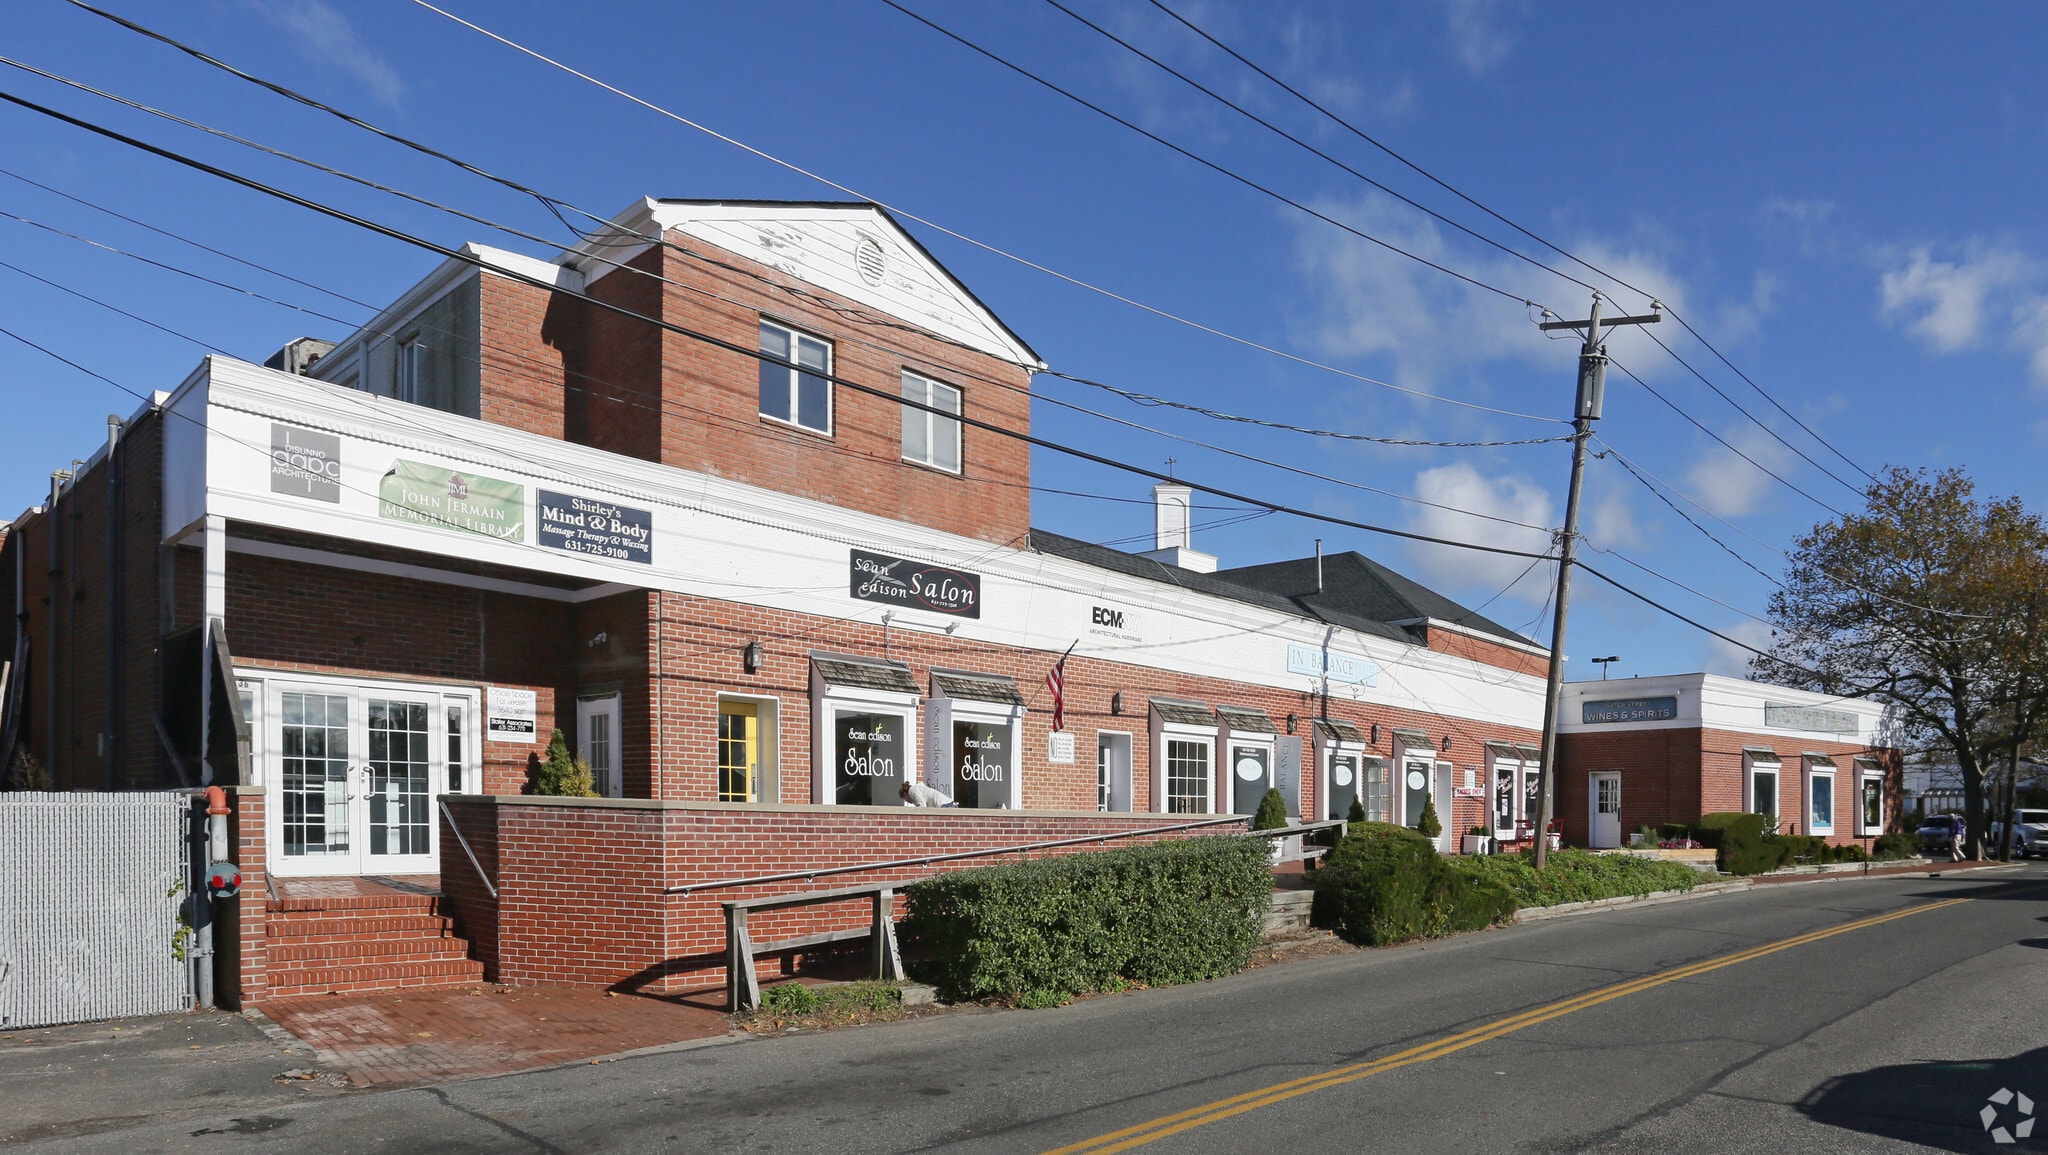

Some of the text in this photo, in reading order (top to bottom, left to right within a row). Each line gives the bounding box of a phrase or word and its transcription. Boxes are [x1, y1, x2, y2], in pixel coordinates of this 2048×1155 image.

[285, 444, 326, 459] DISUNNO
[272, 466, 340, 486] ARCHITECTURE
[571, 498, 622, 519] Shirley's
[542, 505, 649, 542] Mind & Body
[542, 523, 649, 553] Massage Therapy & Waxing
[564, 539, 629, 559] 631-725-9100
[854, 558, 889, 576] Sean
[861, 579, 908, 599] edison
[909, 572, 975, 605] Salon
[1292, 649, 1305, 666] IN
[1311, 653, 1354, 676] BAANCE
[1587, 709, 1670, 721] WINES & SPIRITS
[844, 746, 895, 777] Salon
[961, 754, 1003, 782] Salon
